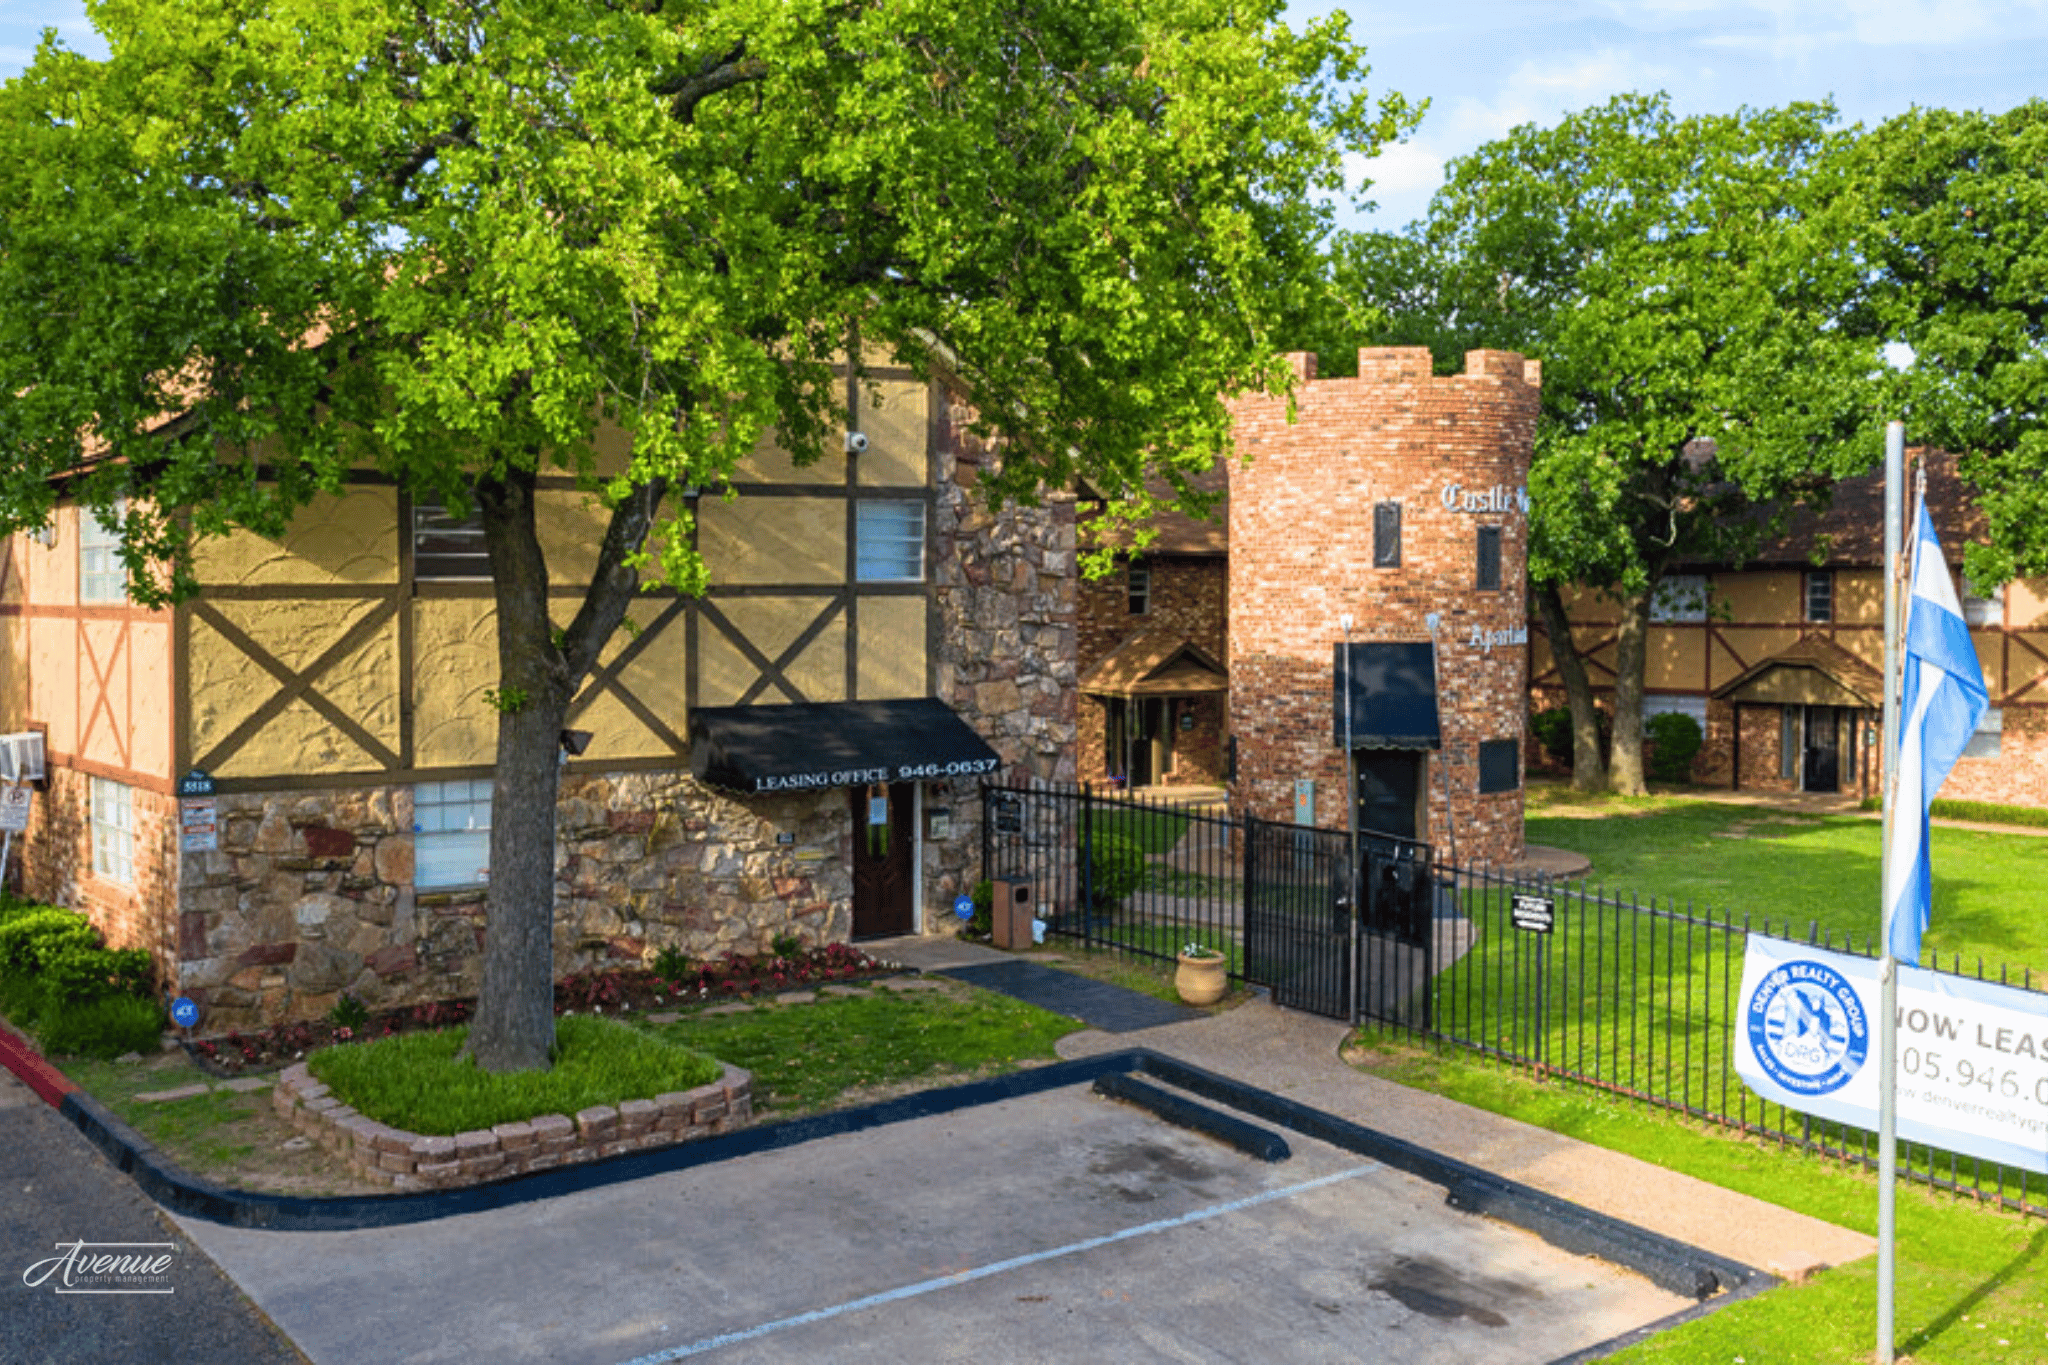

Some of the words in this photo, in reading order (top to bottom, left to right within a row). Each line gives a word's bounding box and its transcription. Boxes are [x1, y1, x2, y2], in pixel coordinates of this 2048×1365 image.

[756, 771, 828, 791] LEASING
[831, 767, 890, 786] OFFICE
[898, 758, 997, 778] 946-0637
[1751, 969, 1788, 1013] DENVER
[1789, 965, 1840, 988] REALTY
[1837, 987, 1865, 1038] GROUP
